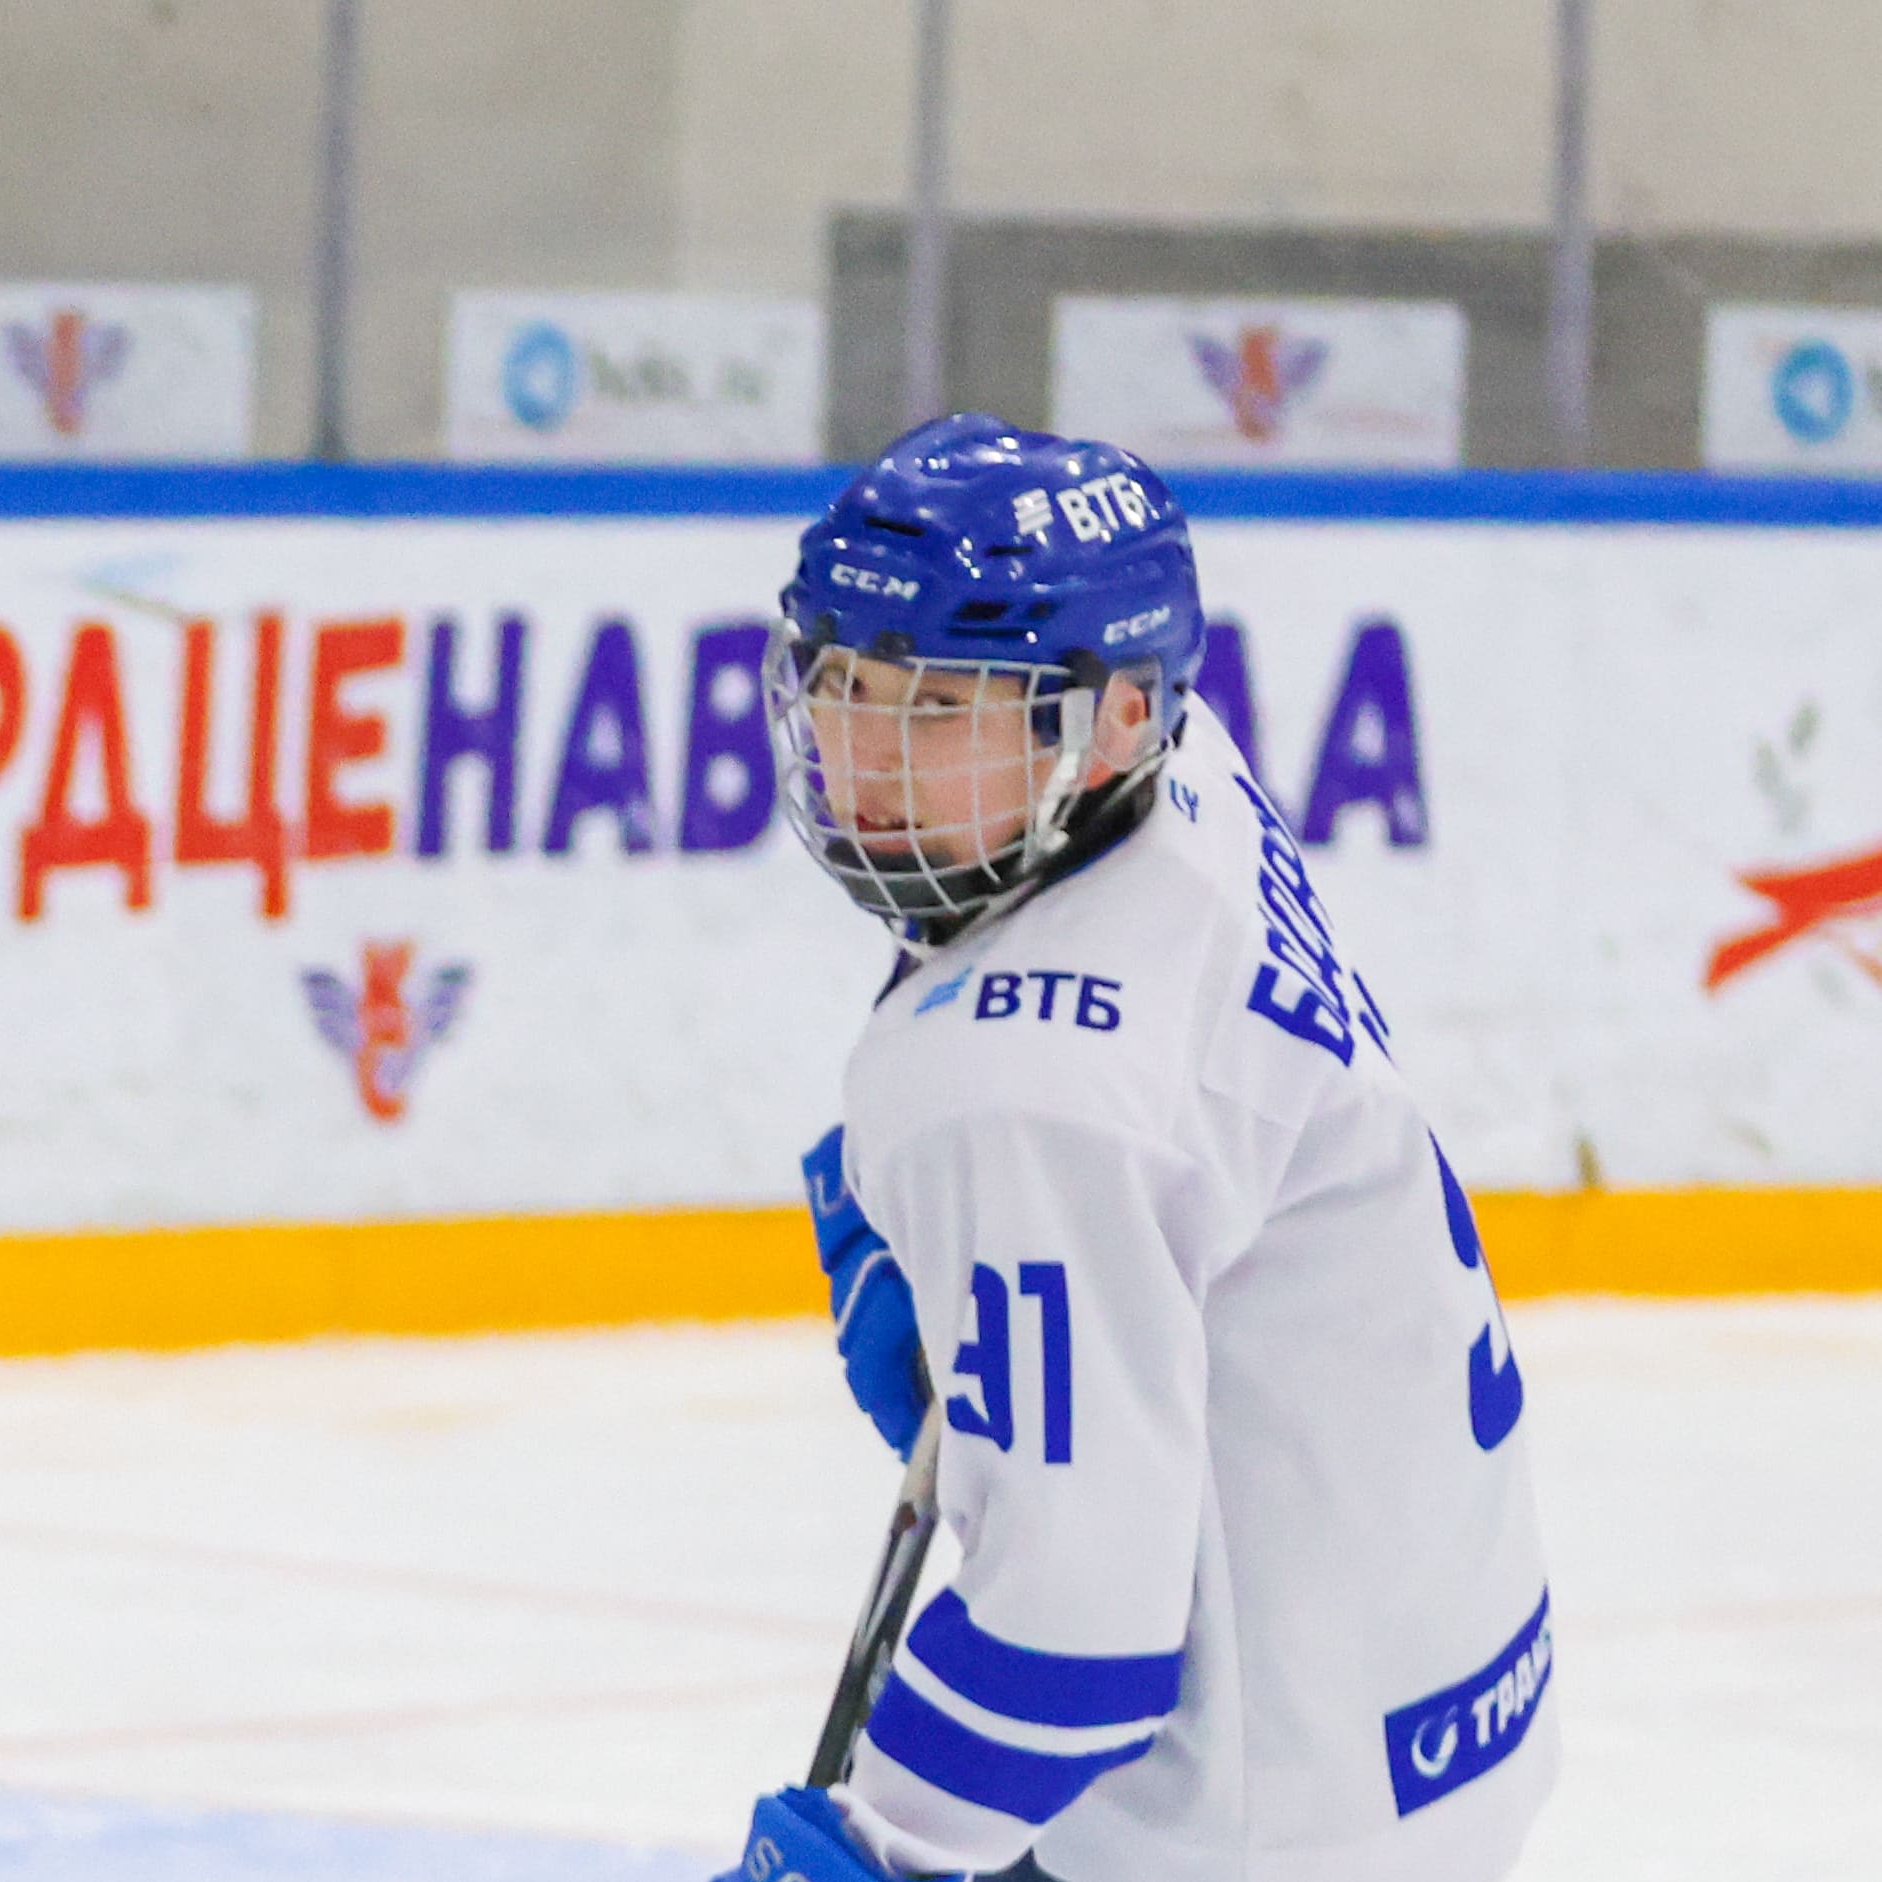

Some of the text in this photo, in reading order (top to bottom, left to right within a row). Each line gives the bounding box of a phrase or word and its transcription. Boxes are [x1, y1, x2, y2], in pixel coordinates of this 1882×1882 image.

[830, 562, 920, 601] CCM
[1102, 605, 1171, 644] CCM
[974, 969, 1123, 1033] ВТБ
